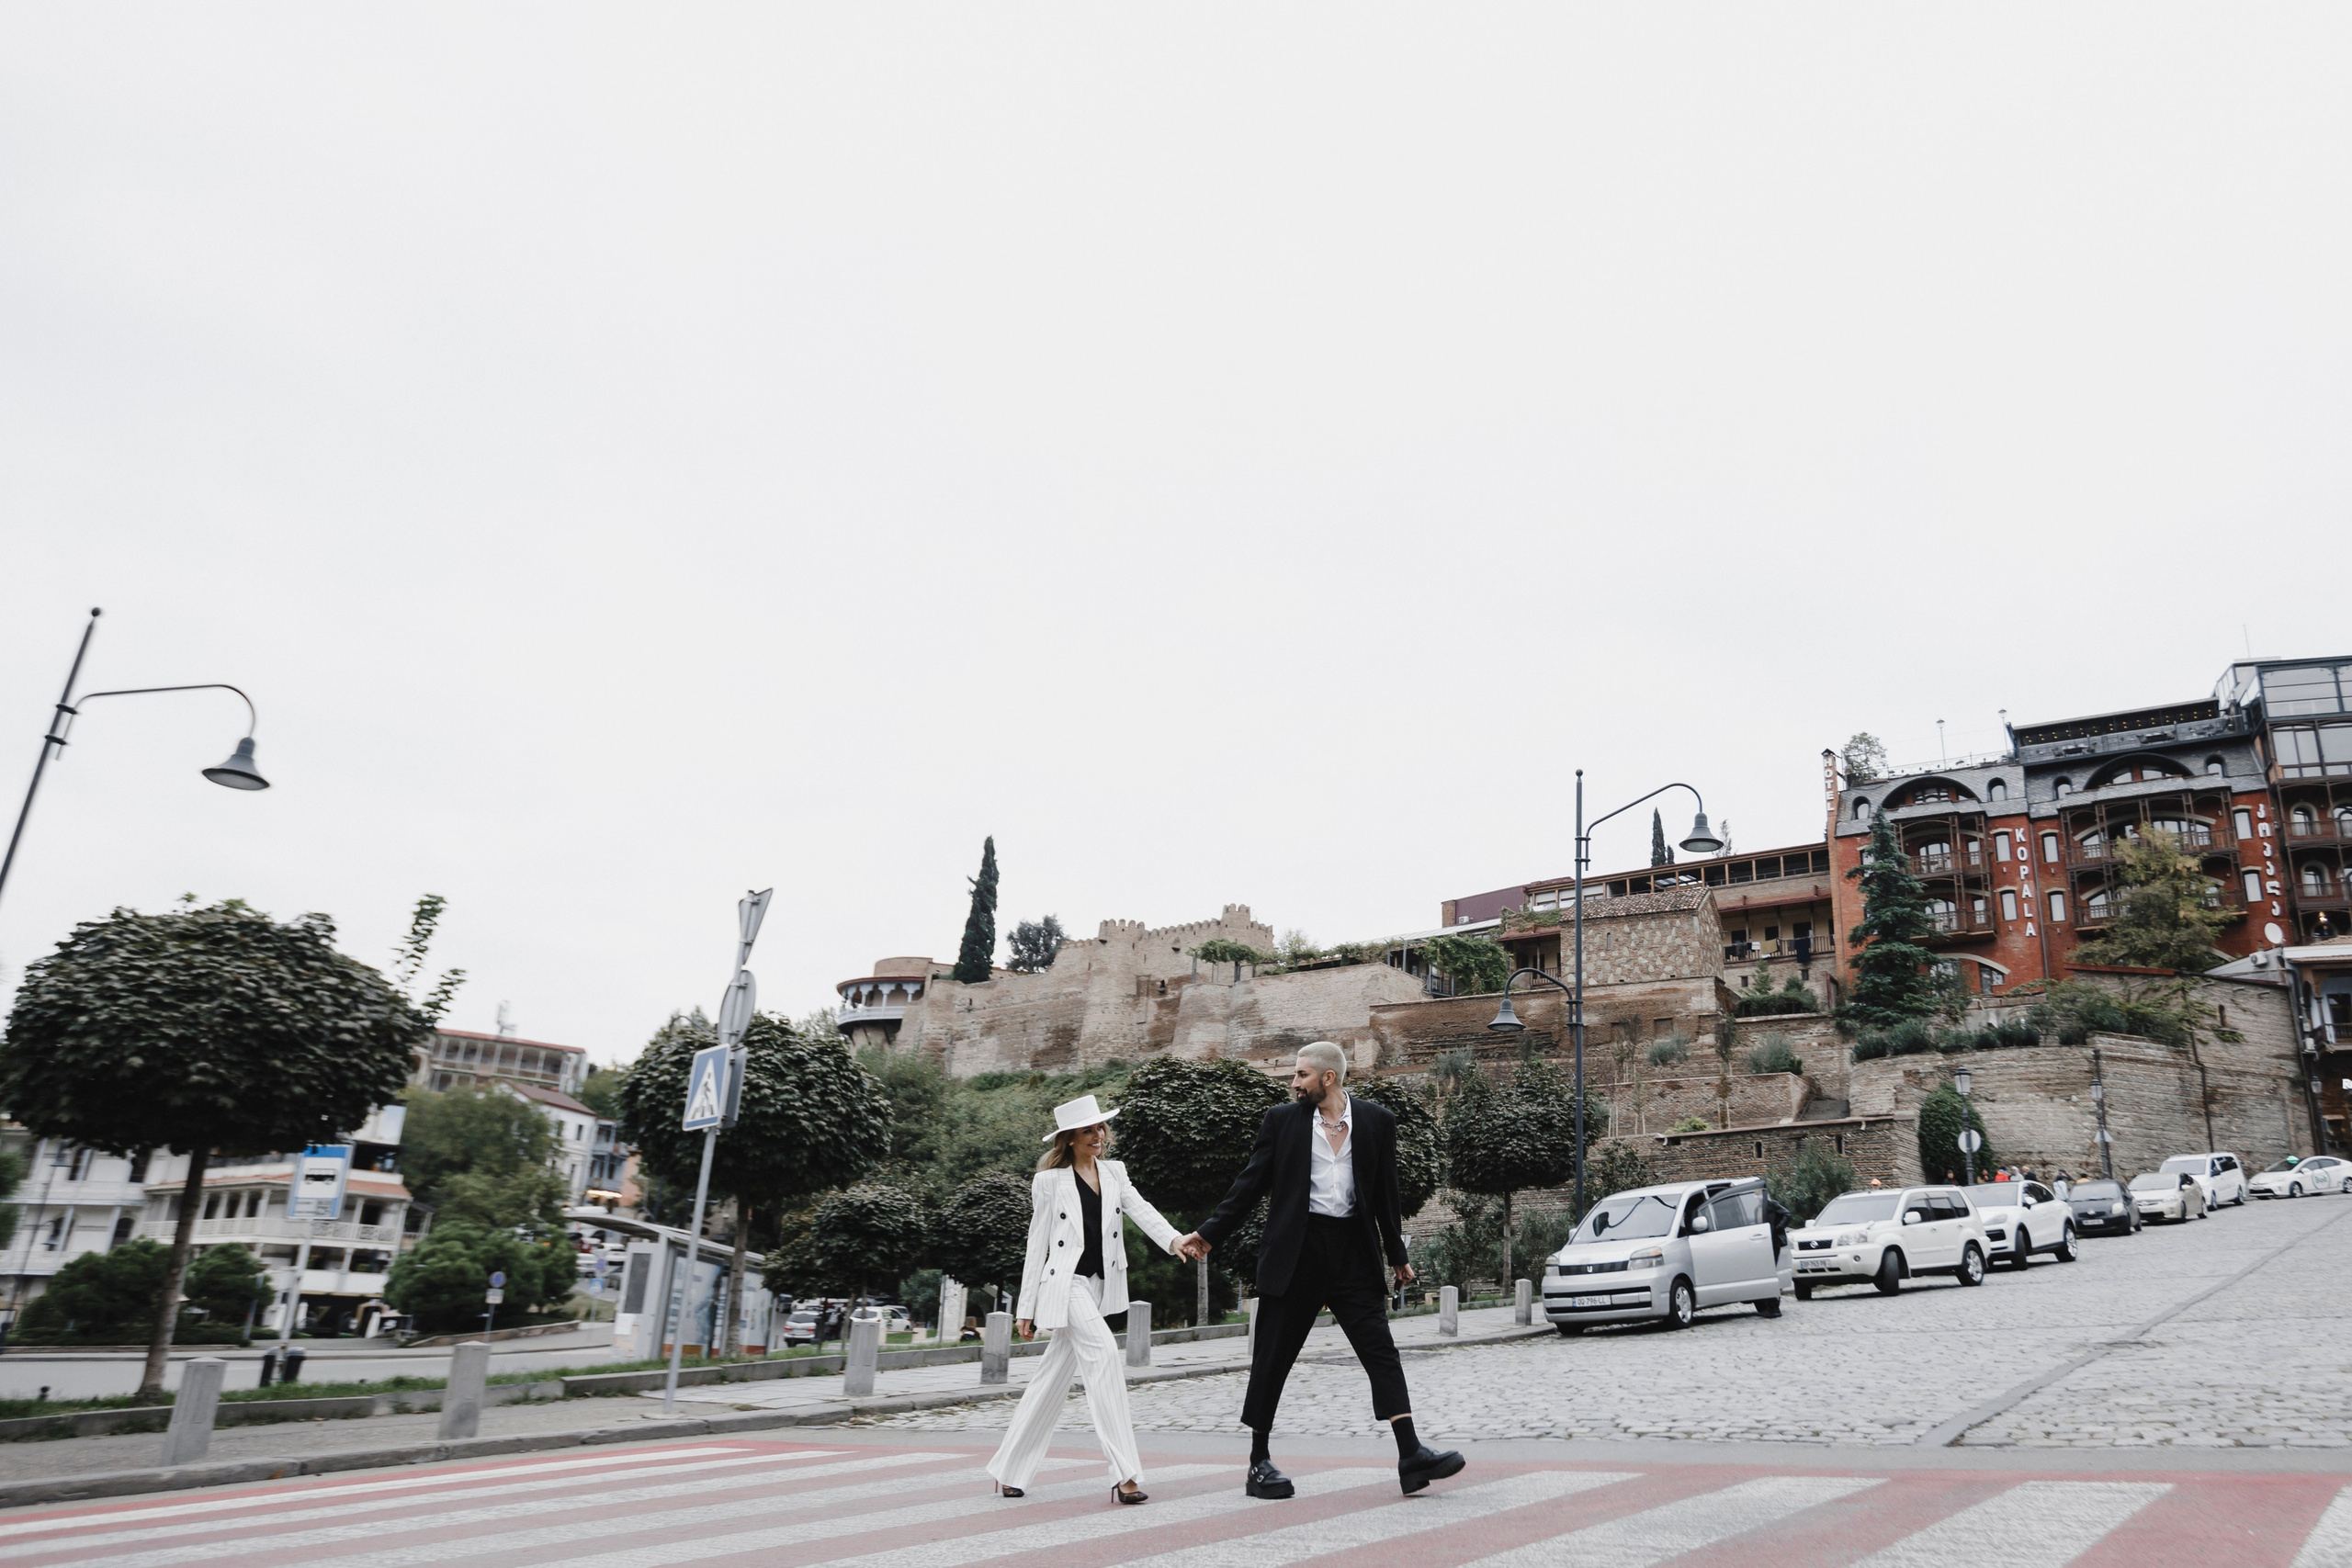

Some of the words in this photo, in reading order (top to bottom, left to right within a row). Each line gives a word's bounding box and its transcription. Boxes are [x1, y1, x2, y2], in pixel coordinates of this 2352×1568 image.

[1823, 757, 1835, 811] HOTEL
[2015, 828, 2037, 937] KOPALA
[2256, 803, 2281, 917] კოპალა
